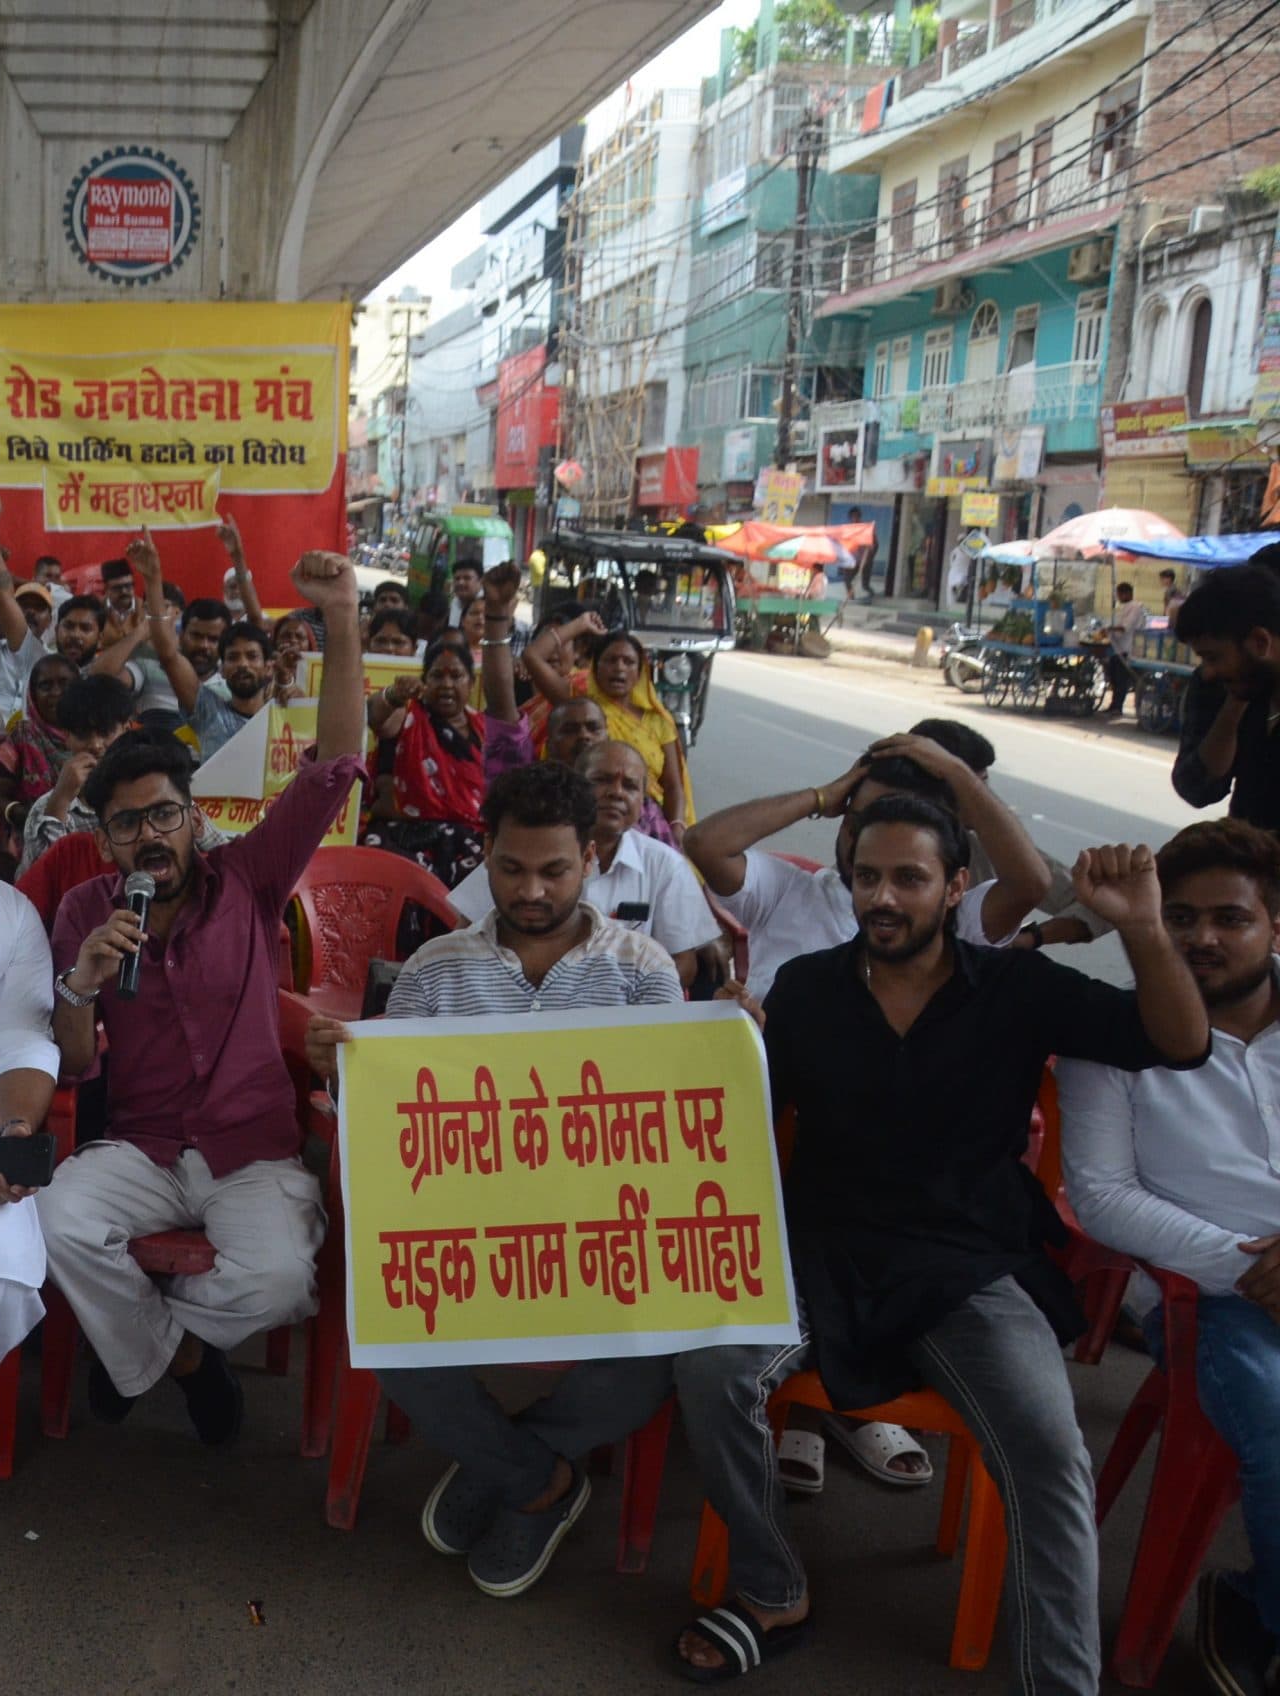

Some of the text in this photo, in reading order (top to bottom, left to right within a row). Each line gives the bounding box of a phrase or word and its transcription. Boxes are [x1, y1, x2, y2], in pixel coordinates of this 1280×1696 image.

[90, 182, 170, 213] Raymond
[95, 214, 164, 227] Hari Suman
[5, 364, 62, 419] रोड
[73, 366, 242, 422] जनचेतना
[253, 364, 315, 422] मंच
[139, 437, 197, 465] हटाने
[203, 443, 235, 465] का
[242, 438, 307, 465] विरोध
[58, 472, 205, 518] में महाधरना
[397, 1060, 728, 1194] ग्रीनरी के कीमत पर
[379, 1180, 764, 1335] सड़क जाम नहीं चाहिए
